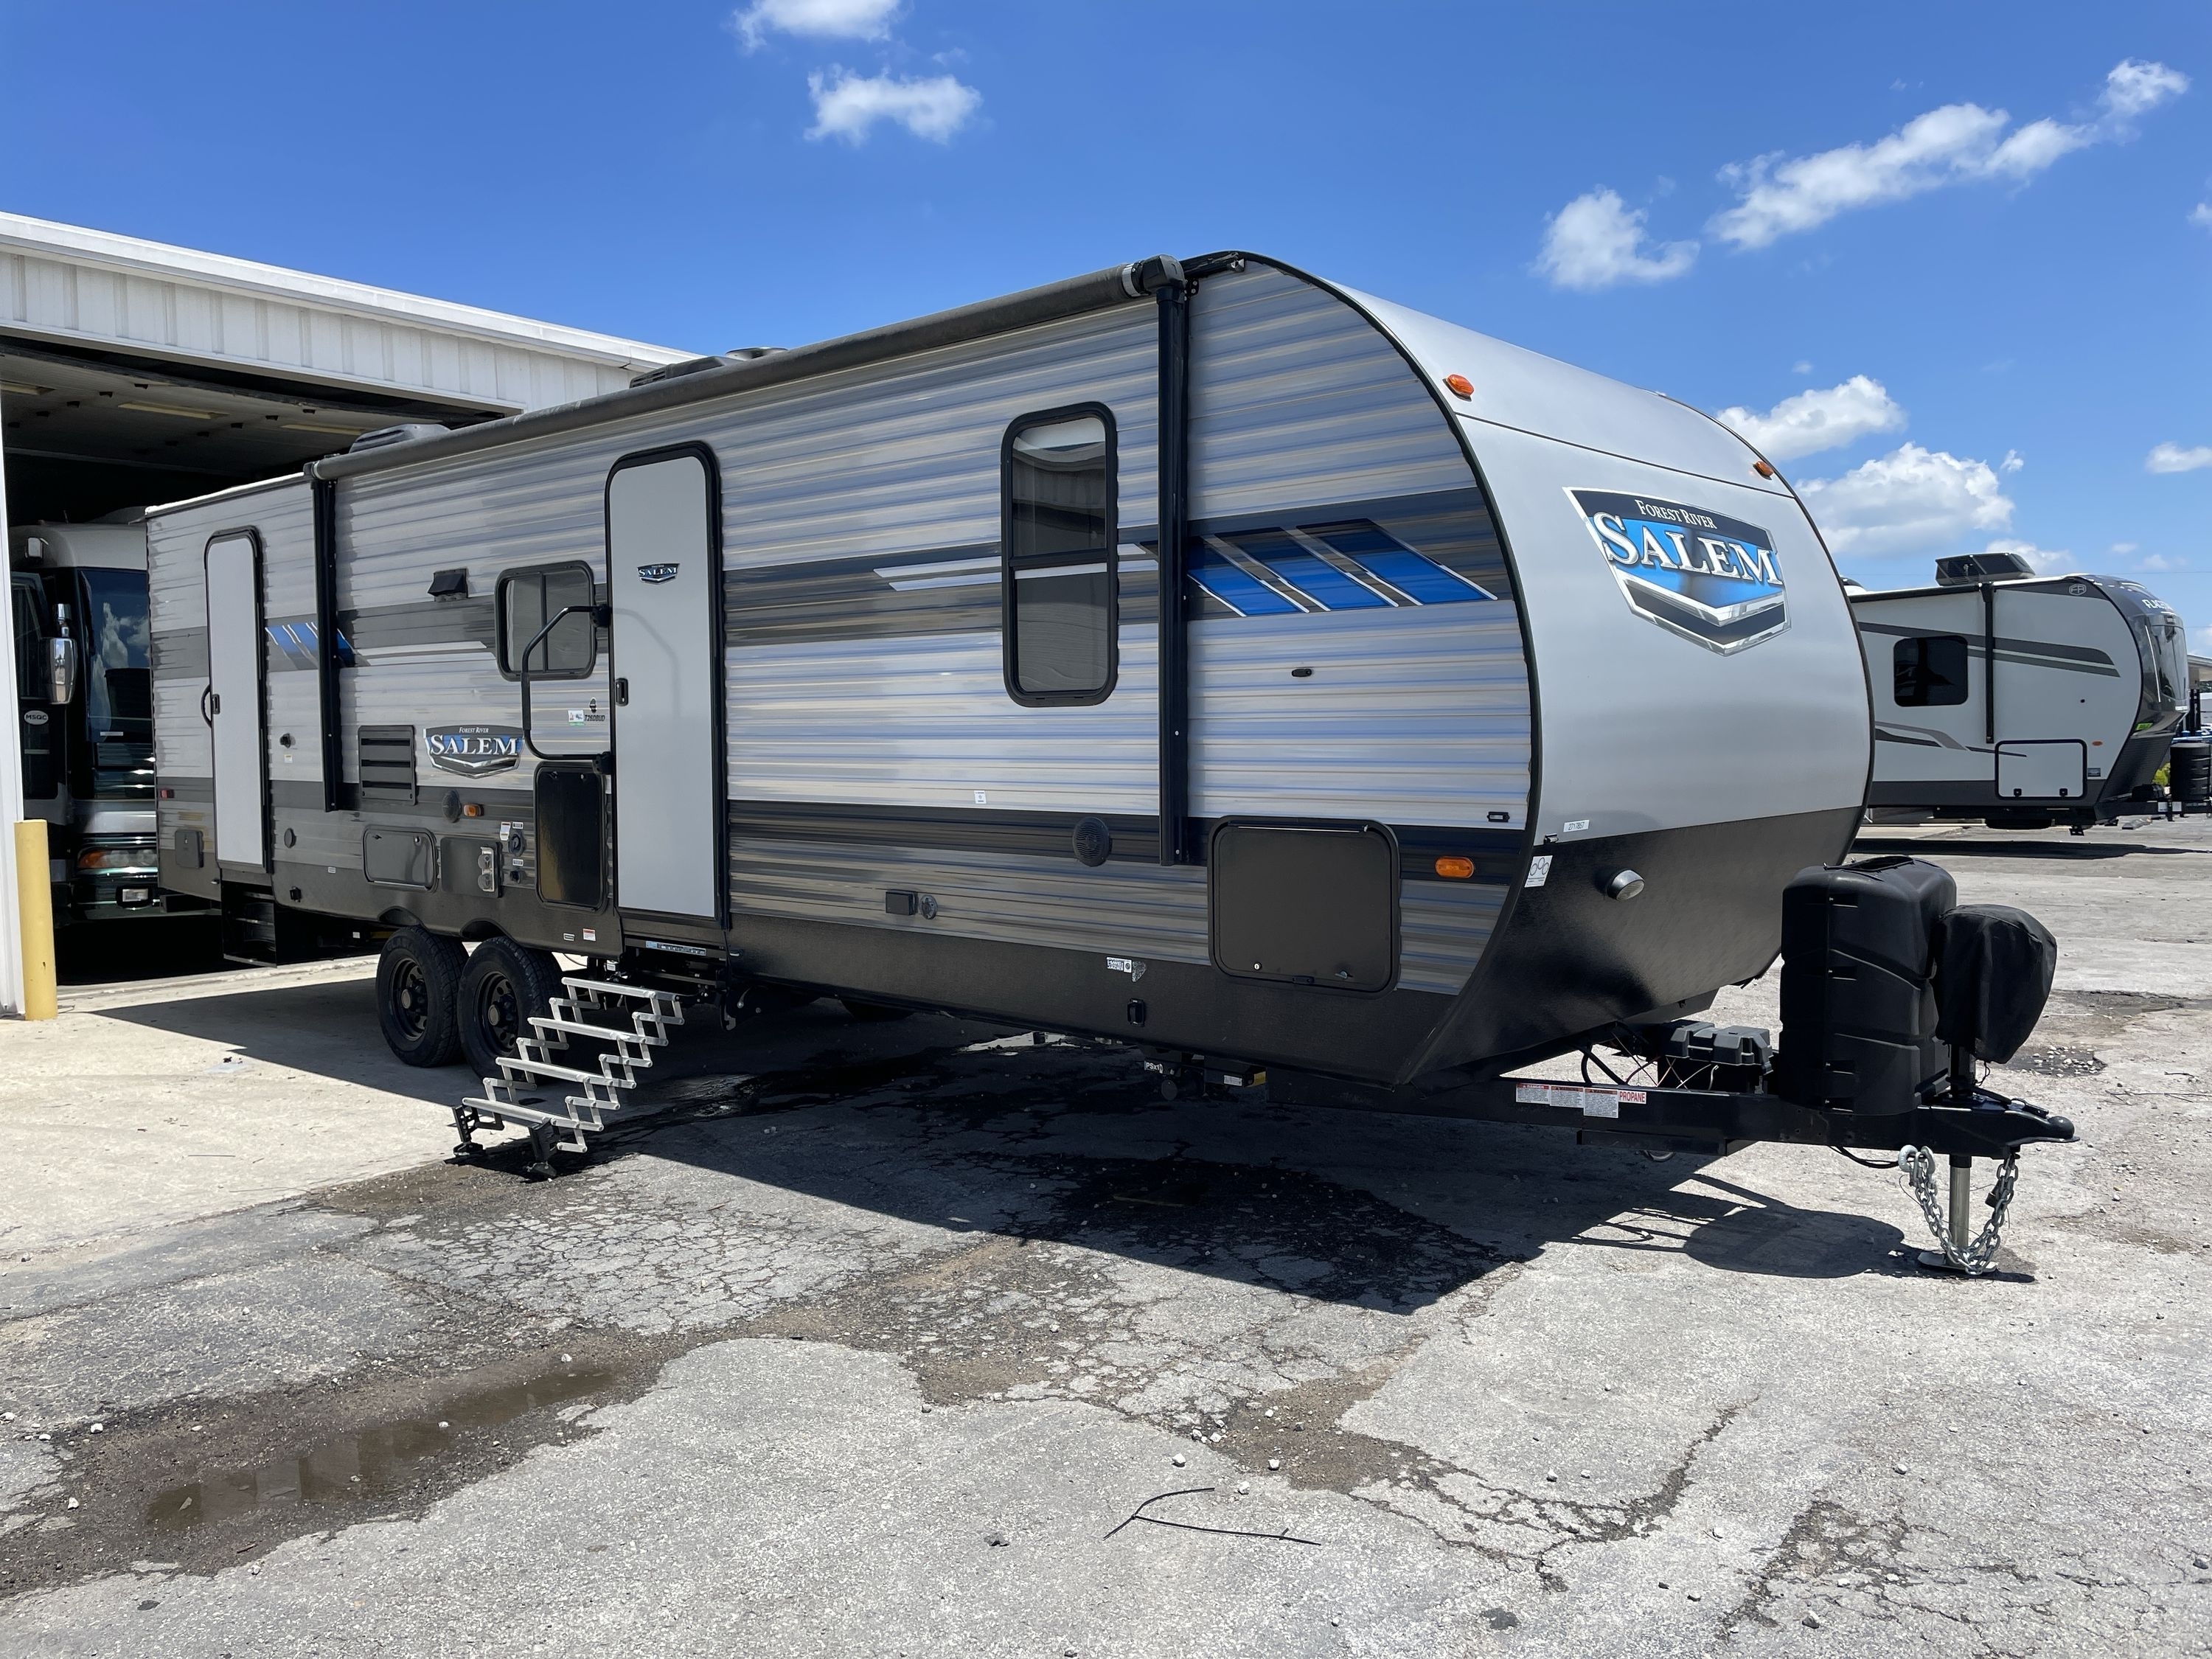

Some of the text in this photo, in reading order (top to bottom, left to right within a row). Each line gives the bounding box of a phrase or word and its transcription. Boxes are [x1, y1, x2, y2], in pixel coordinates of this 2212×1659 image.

[1635, 498, 1718, 529] FOREST RIVER
[1593, 511, 1784, 585] SALEM
[639, 567, 677, 577] SALEM
[431, 734, 518, 756] SALEM
[1619, 1091, 1646, 1103] PROPANE
